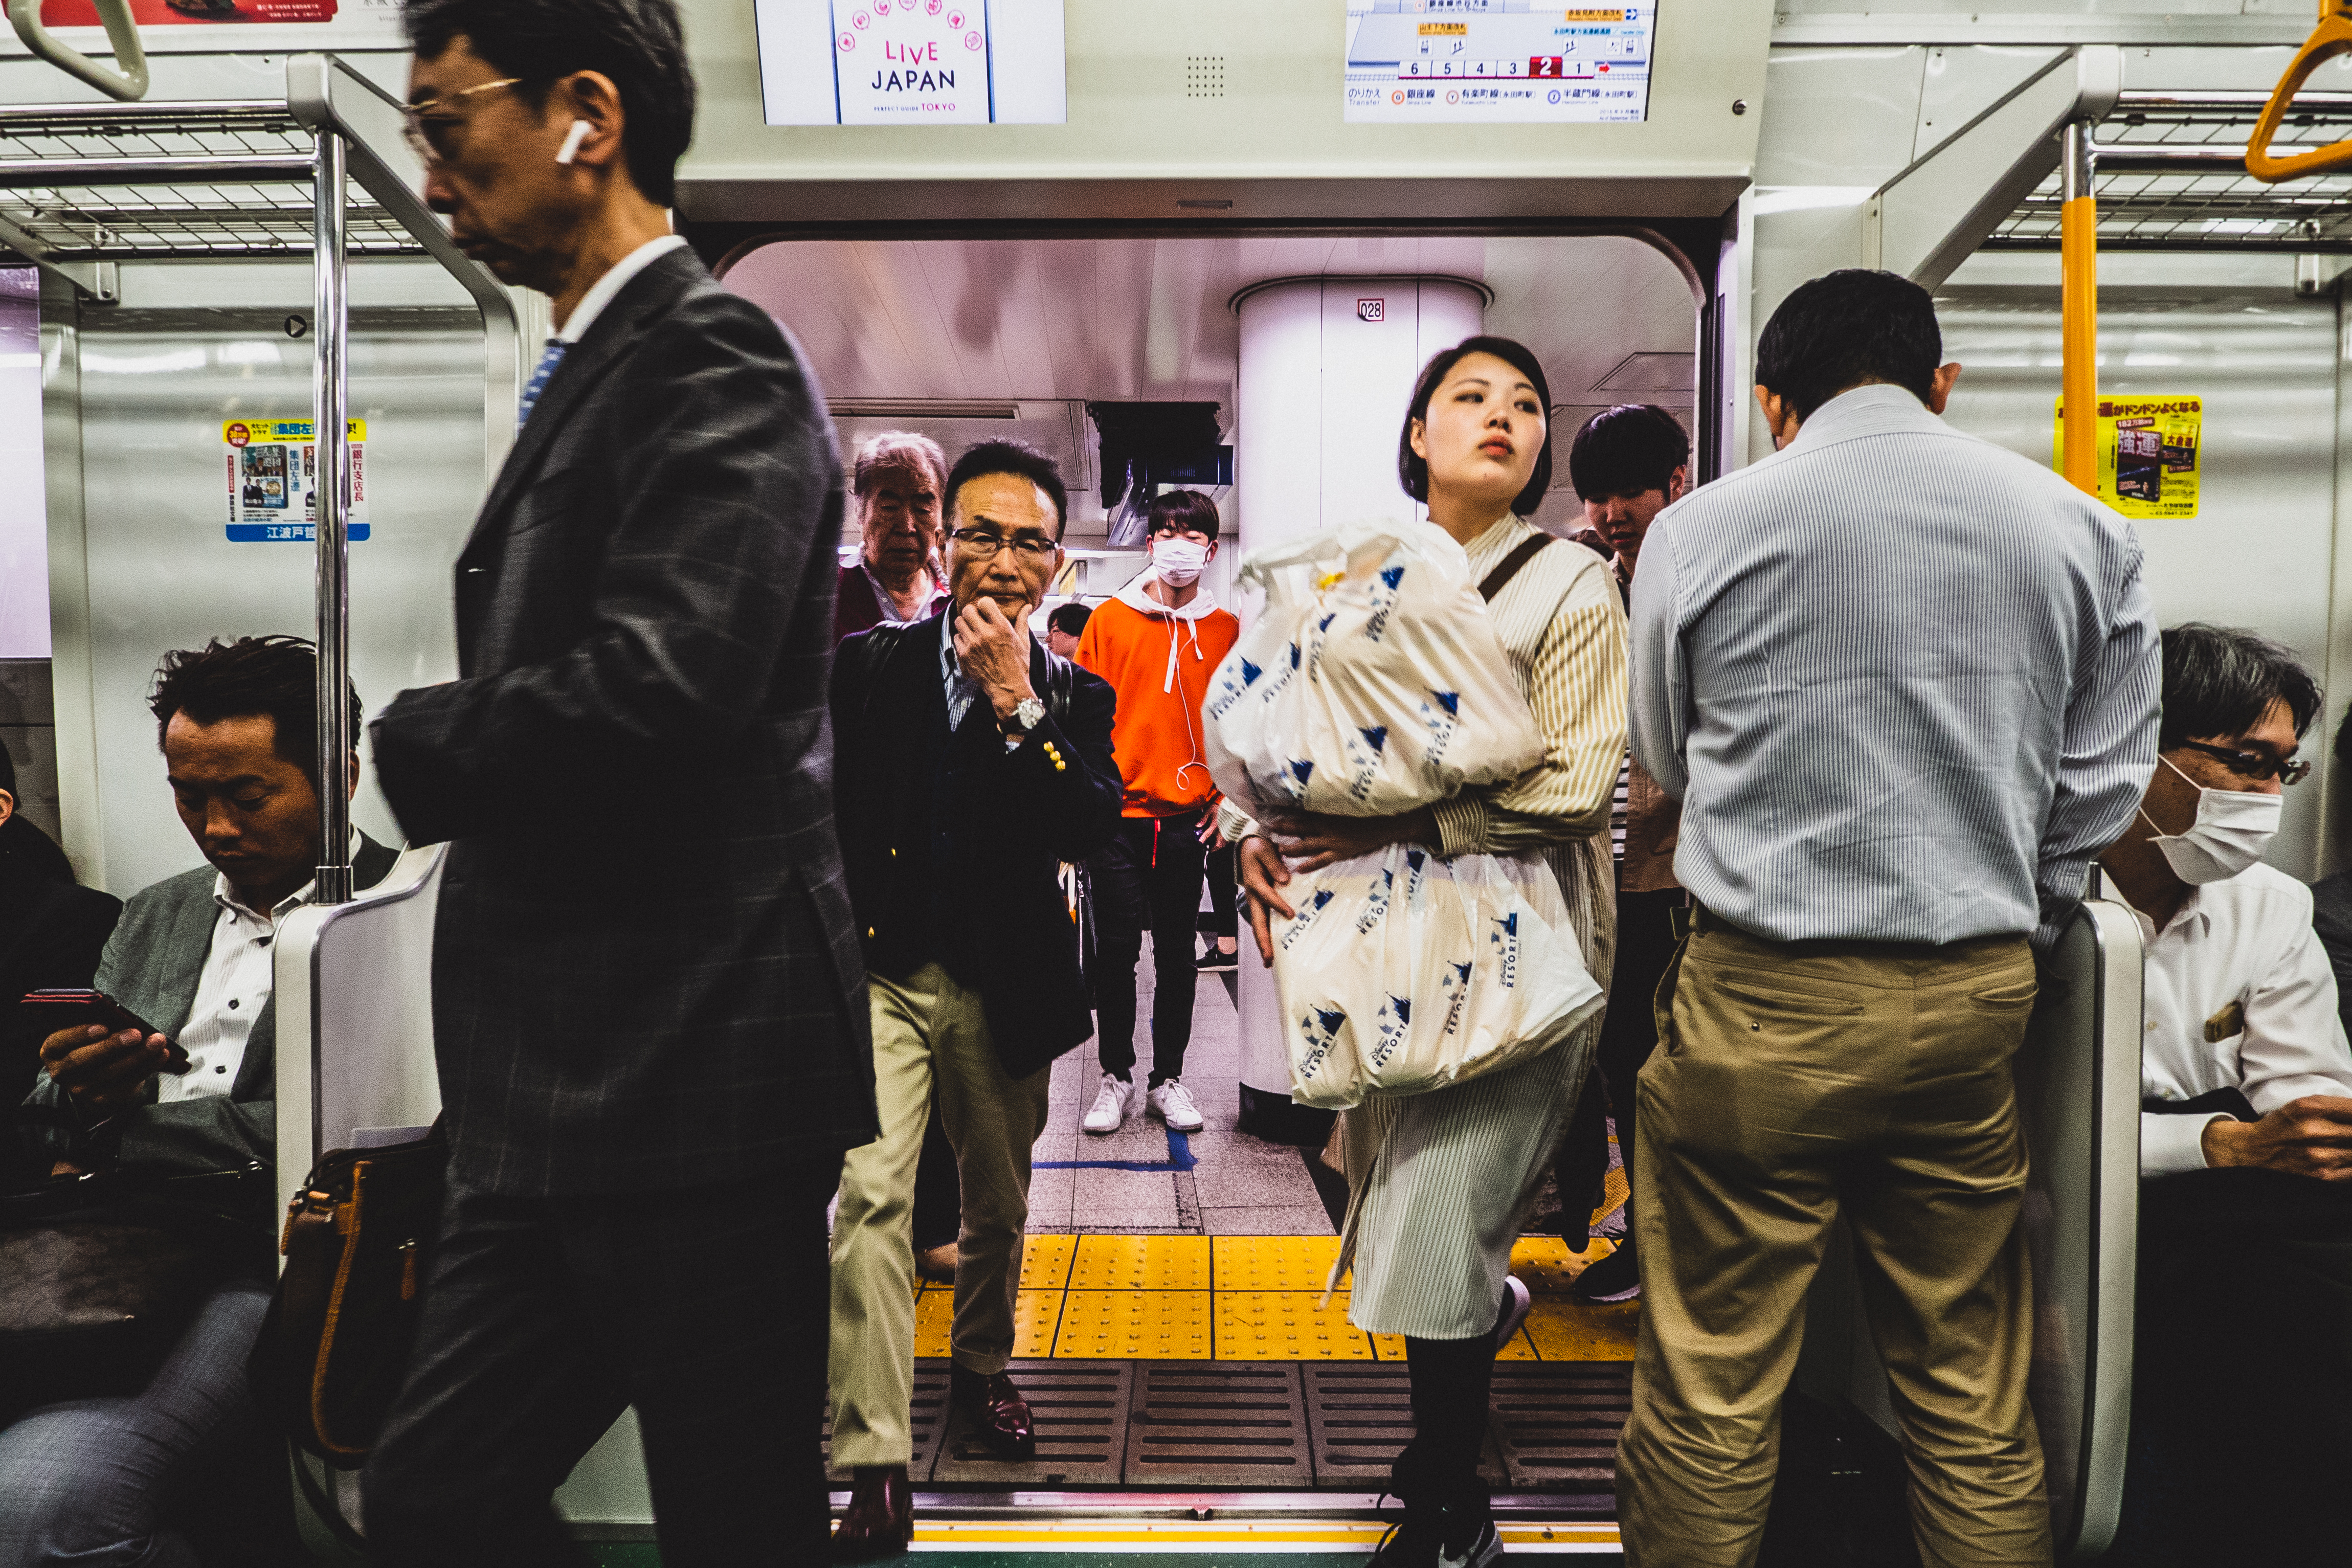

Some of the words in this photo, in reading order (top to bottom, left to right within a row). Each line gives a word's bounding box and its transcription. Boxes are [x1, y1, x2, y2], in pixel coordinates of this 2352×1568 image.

[886, 40, 938, 66] LIVE
[1412, 62, 1418, 75] 6
[1445, 62, 1451, 75] 5
[1476, 62, 1484, 75] 4
[1510, 62, 1516, 75] 3
[1539, 57, 1552, 76] 2
[1576, 62, 1581, 75] 1
[871, 70, 955, 92] JAPAN
[1349, 88, 1381, 98] のりかえ
[1407, 89, 1435, 98] 銀座線
[922, 103, 956, 111] TOKYO
[1360, 302, 1381, 317] 028
[2098, 401, 2201, 417] 運がドンドンよくなる
[1506, 937, 1517, 989] RESORT
[1375, 1023, 1407, 1068] RESORT
[1304, 1034, 1333, 1079] RESORT
